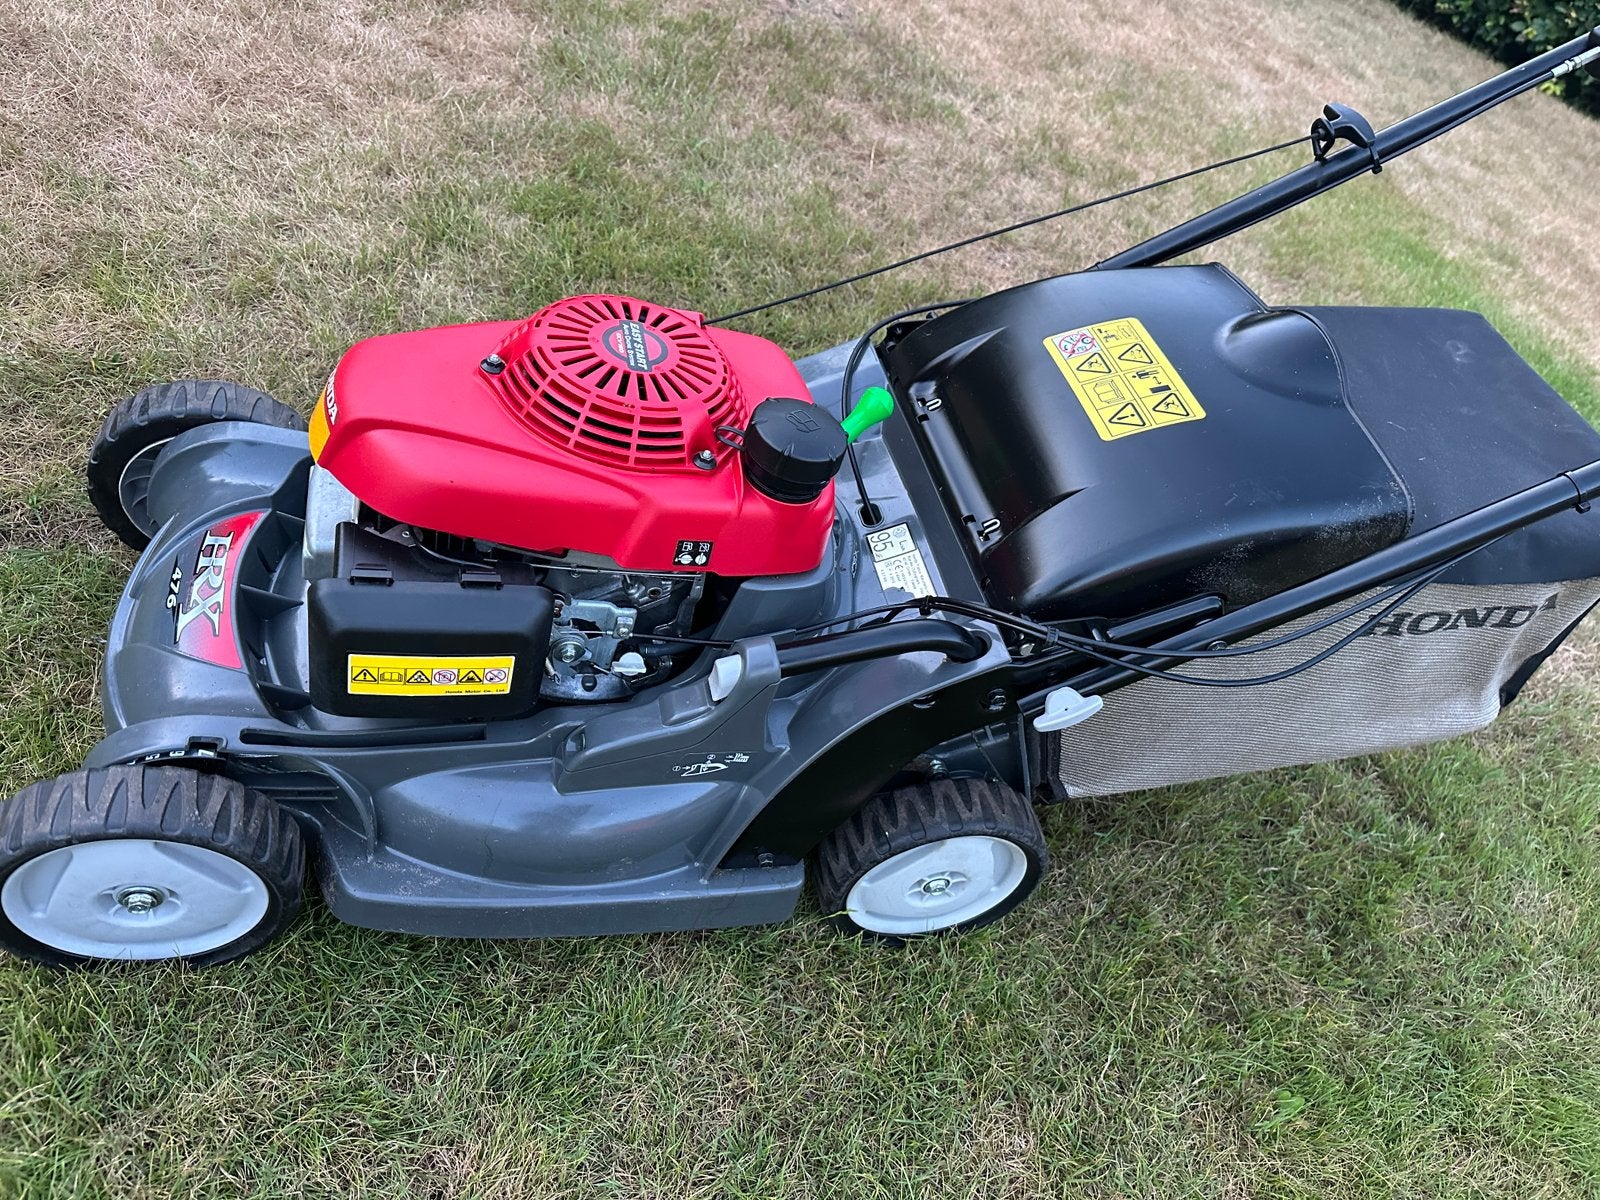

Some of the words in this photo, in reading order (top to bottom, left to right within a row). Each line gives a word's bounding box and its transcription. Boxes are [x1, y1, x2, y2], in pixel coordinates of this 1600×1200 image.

[630, 322, 642, 345] EASY
[634, 343, 648, 370] START
[870, 532, 894, 553] 95
[166, 567, 182, 609] 476
[174, 529, 234, 645] HRX
